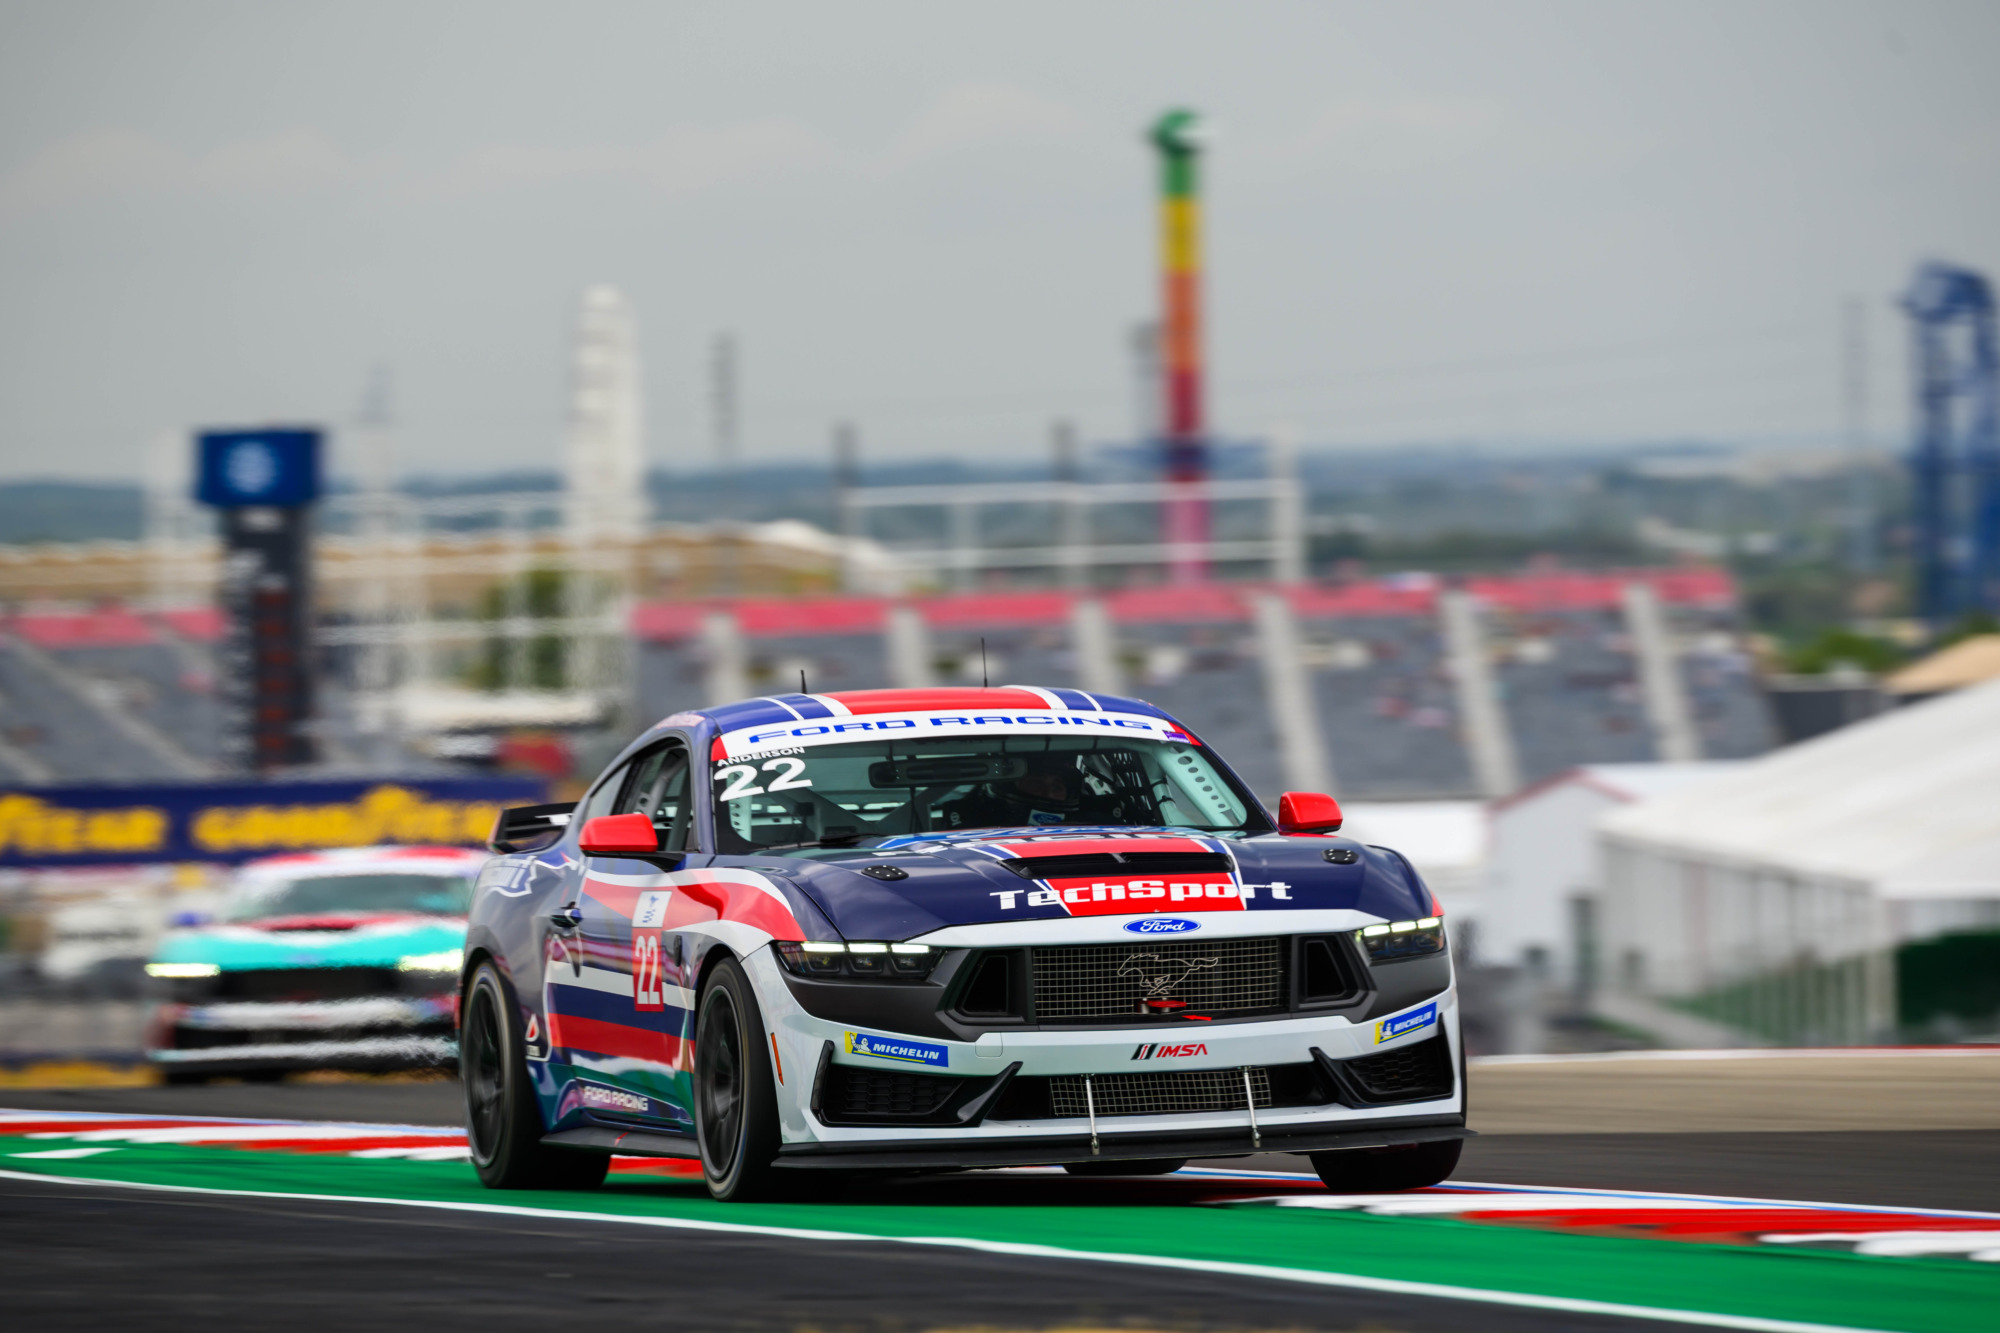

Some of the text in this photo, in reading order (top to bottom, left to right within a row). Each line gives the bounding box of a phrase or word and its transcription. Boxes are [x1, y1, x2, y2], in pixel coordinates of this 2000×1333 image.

[749, 716, 1153, 743] FORD RACING
[717, 747, 805, 767] ANDERSON
[714, 757, 813, 802] 22
[990, 881, 1293, 910] TechSport
[1140, 919, 1186, 932] Ford
[635, 936, 660, 1004] 22
[1393, 1011, 1433, 1033] MICHELIN
[872, 1043, 940, 1060] MICHELIN
[1156, 1044, 1208, 1058] IMSA
[584, 1086, 648, 1111] FORD RACING
